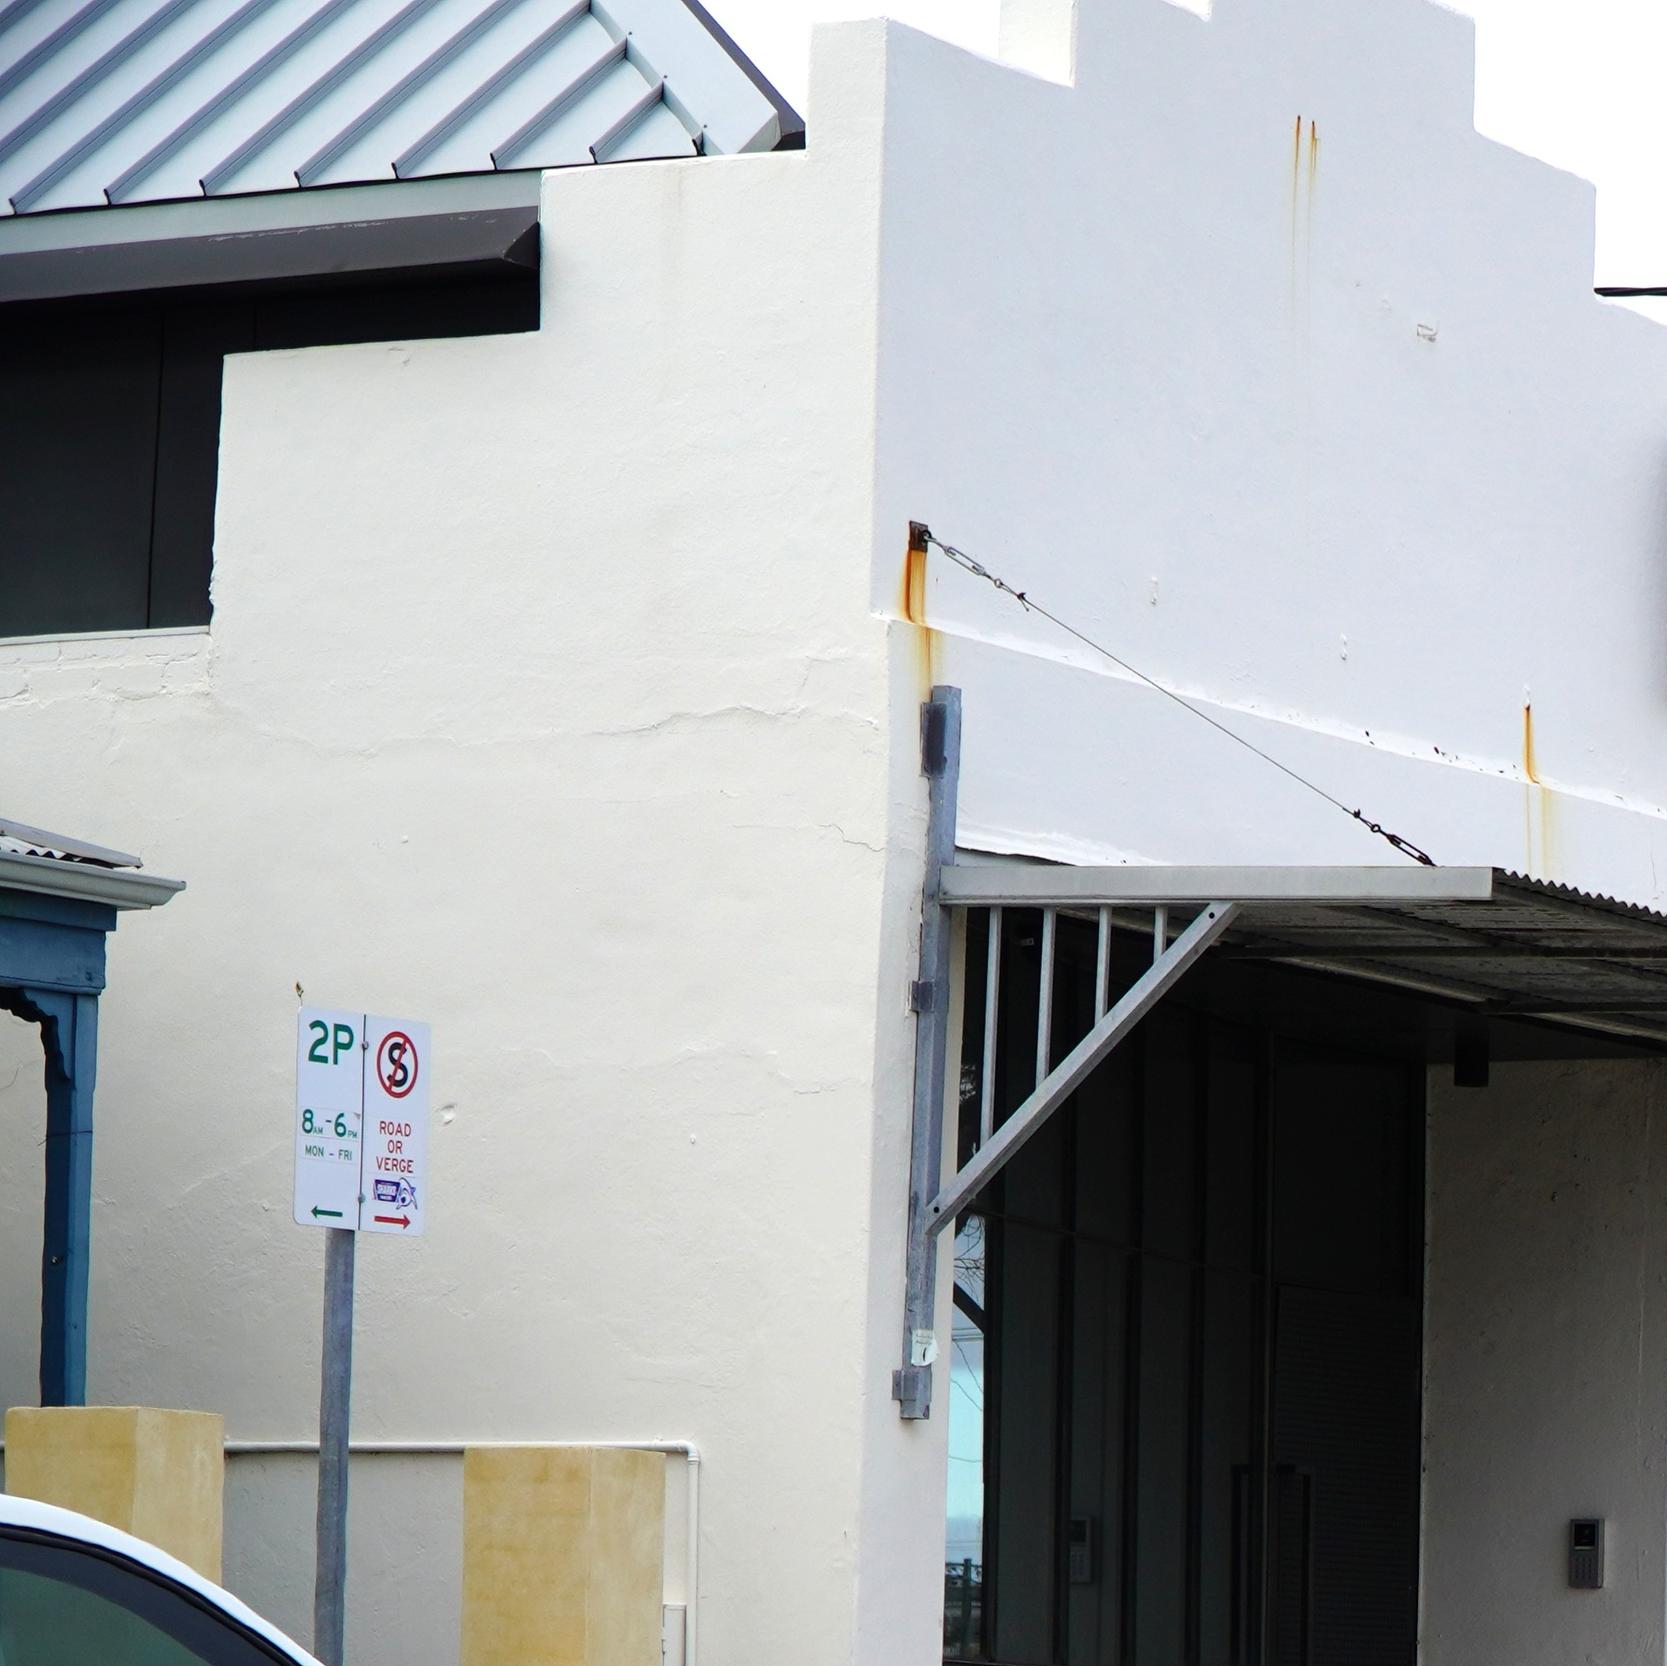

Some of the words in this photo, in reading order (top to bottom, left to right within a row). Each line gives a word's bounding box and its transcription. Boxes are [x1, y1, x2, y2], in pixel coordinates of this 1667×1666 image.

[308, 1020, 354, 1065] 2P
[379, 1121, 412, 1137] ROAD
[305, 1144, 325, 1157] MON
[338, 1149, 353, 1161] FRI
[387, 1140, 403, 1155] OR
[376, 1156, 414, 1173] VERGE
